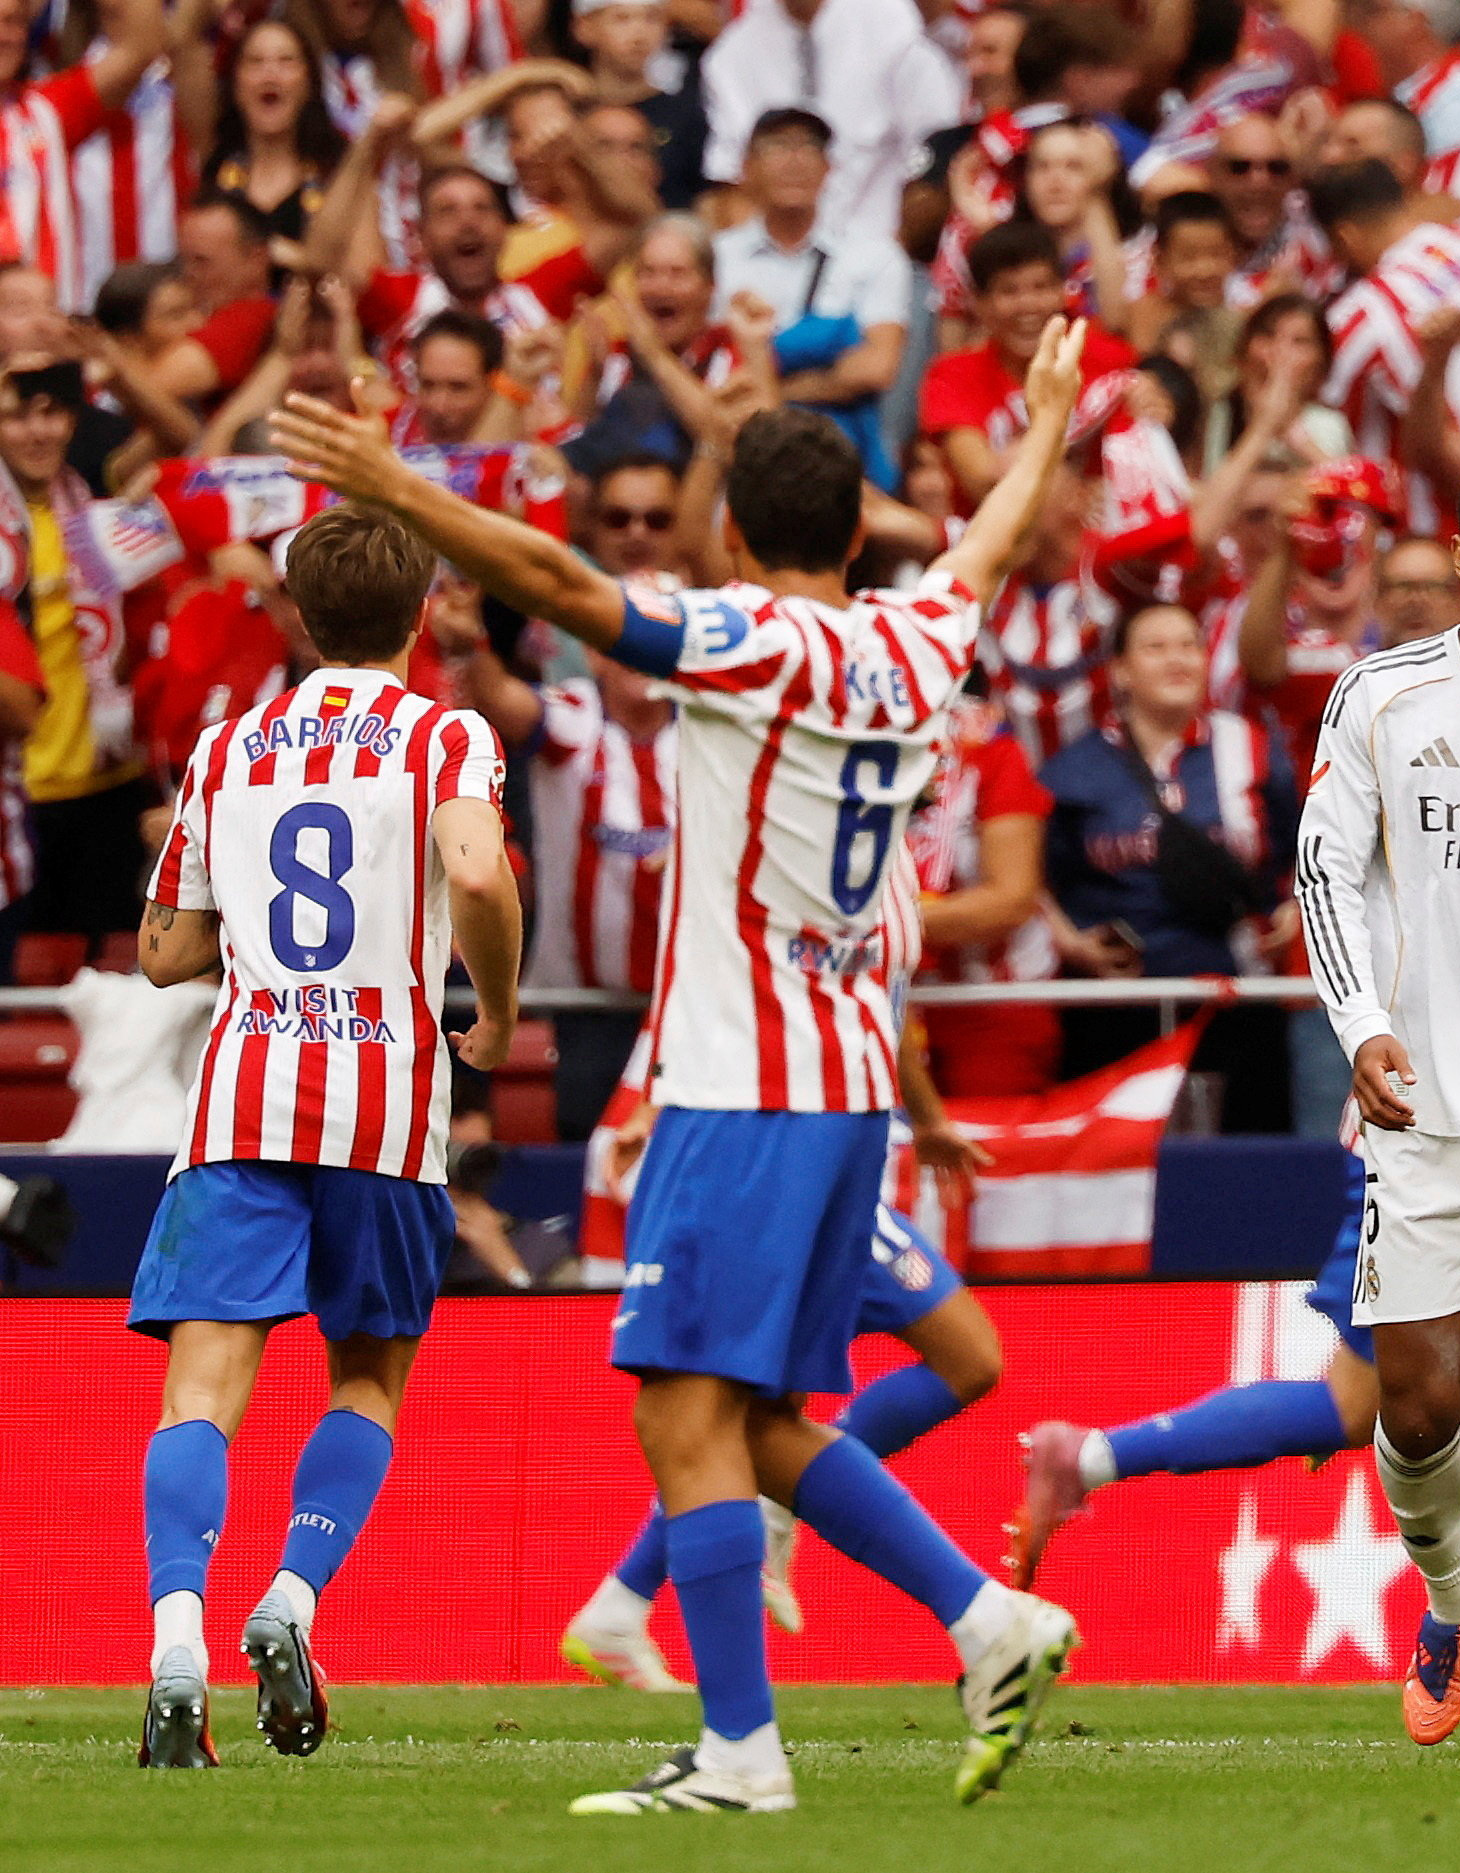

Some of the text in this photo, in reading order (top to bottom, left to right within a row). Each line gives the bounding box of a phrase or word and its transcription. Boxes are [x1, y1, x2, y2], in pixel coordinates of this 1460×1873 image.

[242, 714, 402, 763] BARRIOS
[831, 740, 900, 916] 6
[269, 801, 355, 972] 8
[269, 987, 357, 1015] VISIT
[237, 1012, 397, 1043] RWANDA
